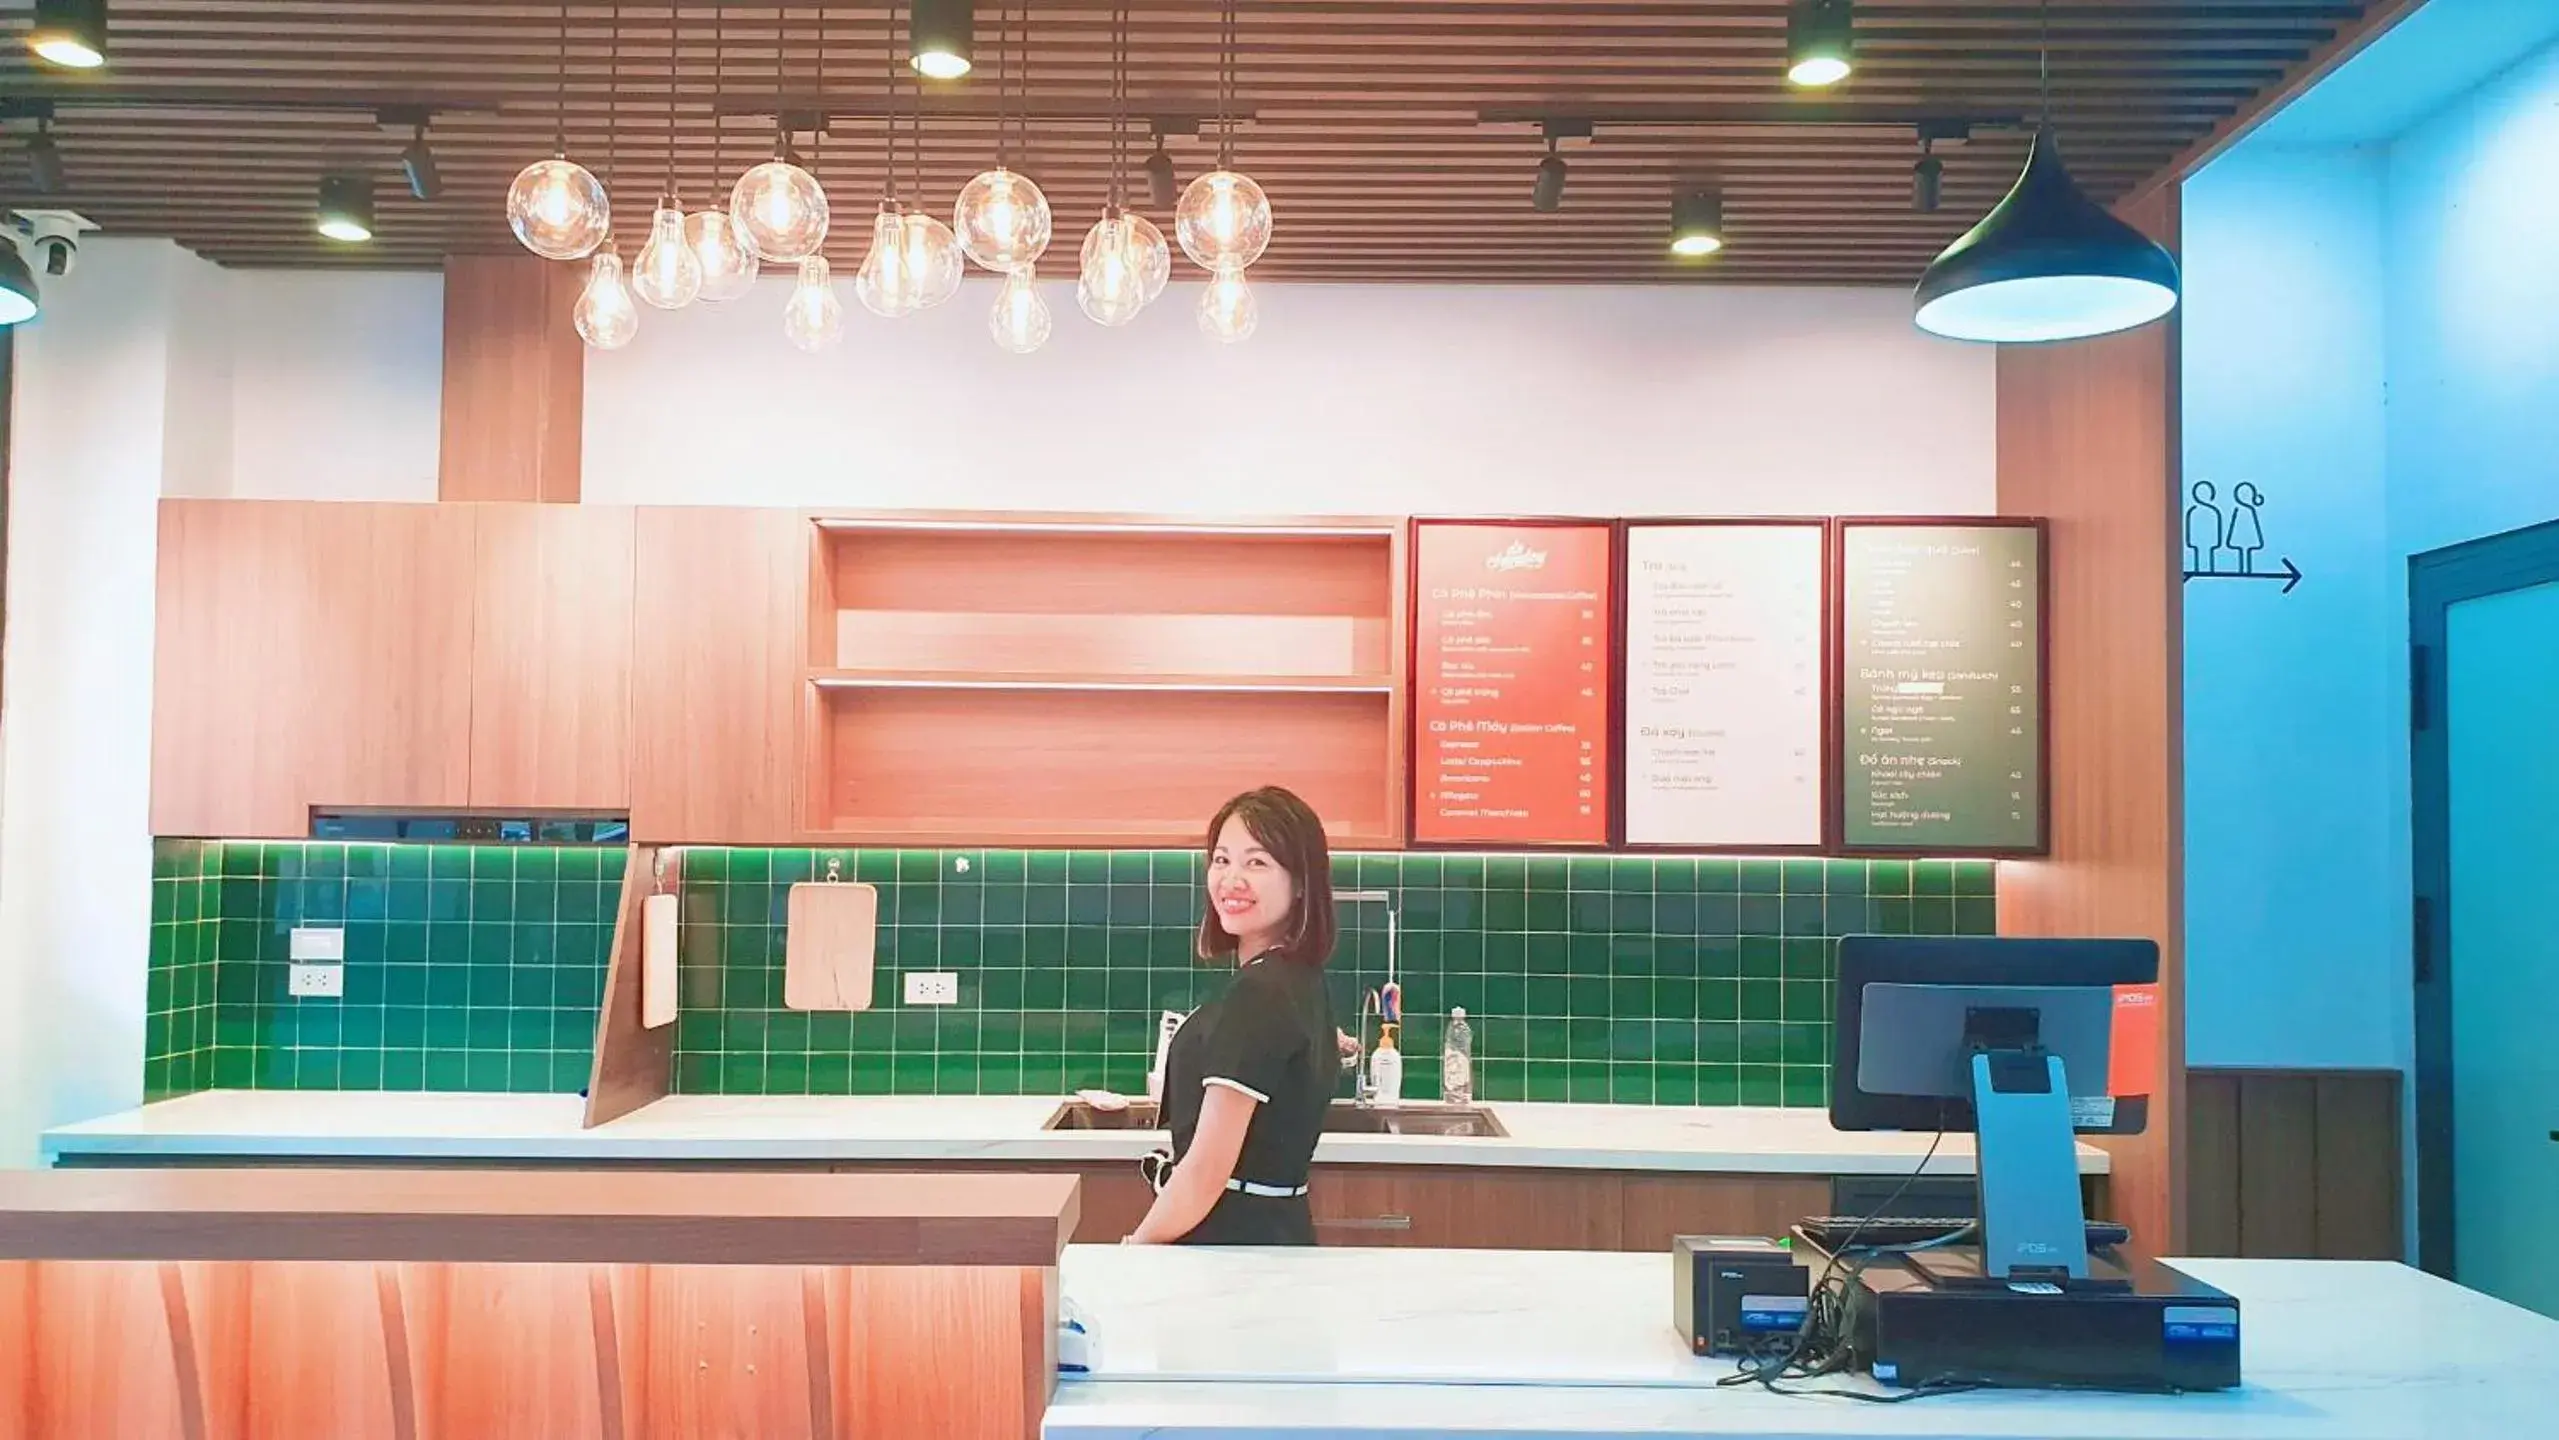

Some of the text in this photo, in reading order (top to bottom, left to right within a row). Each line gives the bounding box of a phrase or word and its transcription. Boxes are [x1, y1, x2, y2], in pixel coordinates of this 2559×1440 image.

[1451, 586, 1476, 601] Phê
[1860, 667, 1895, 680] Bánh
[1430, 719, 1447, 732] Cà
[1449, 718, 1475, 732] Phê
[1476, 719, 1508, 735] Máy
